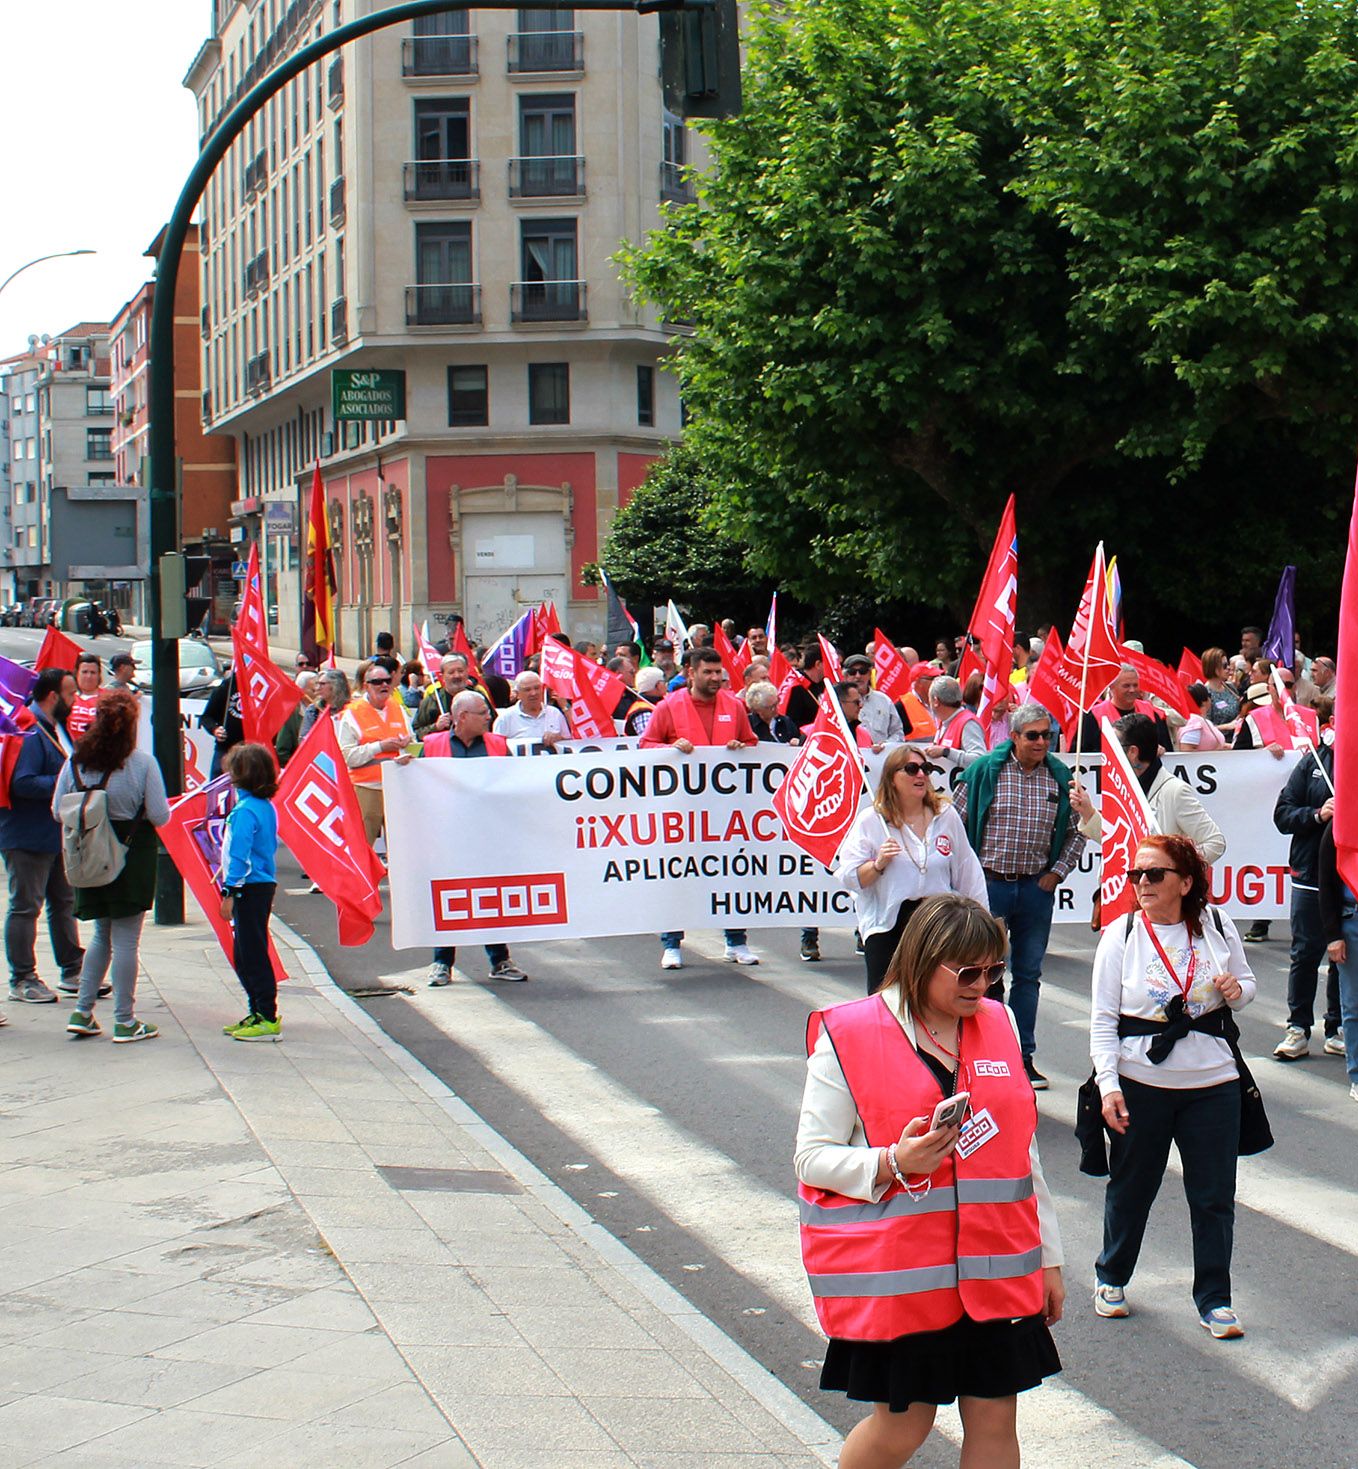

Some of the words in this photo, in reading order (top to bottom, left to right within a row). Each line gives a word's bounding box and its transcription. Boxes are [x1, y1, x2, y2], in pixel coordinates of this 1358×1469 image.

[341, 390, 392, 401] ABOGADOS
[350, 373, 380, 389] S&P
[340, 403, 392, 414] ASOCIADOS
[555, 761, 871, 801] CONDUCTO
[789, 739, 835, 813] UGT
[603, 848, 768, 882] APLICACIÓN
[779, 854, 814, 876] DE
[1207, 865, 1291, 907] UGT
[440, 884, 557, 921] CCOO
[976, 1065, 1008, 1075] CCOO
[959, 1120, 990, 1148] CCOO
